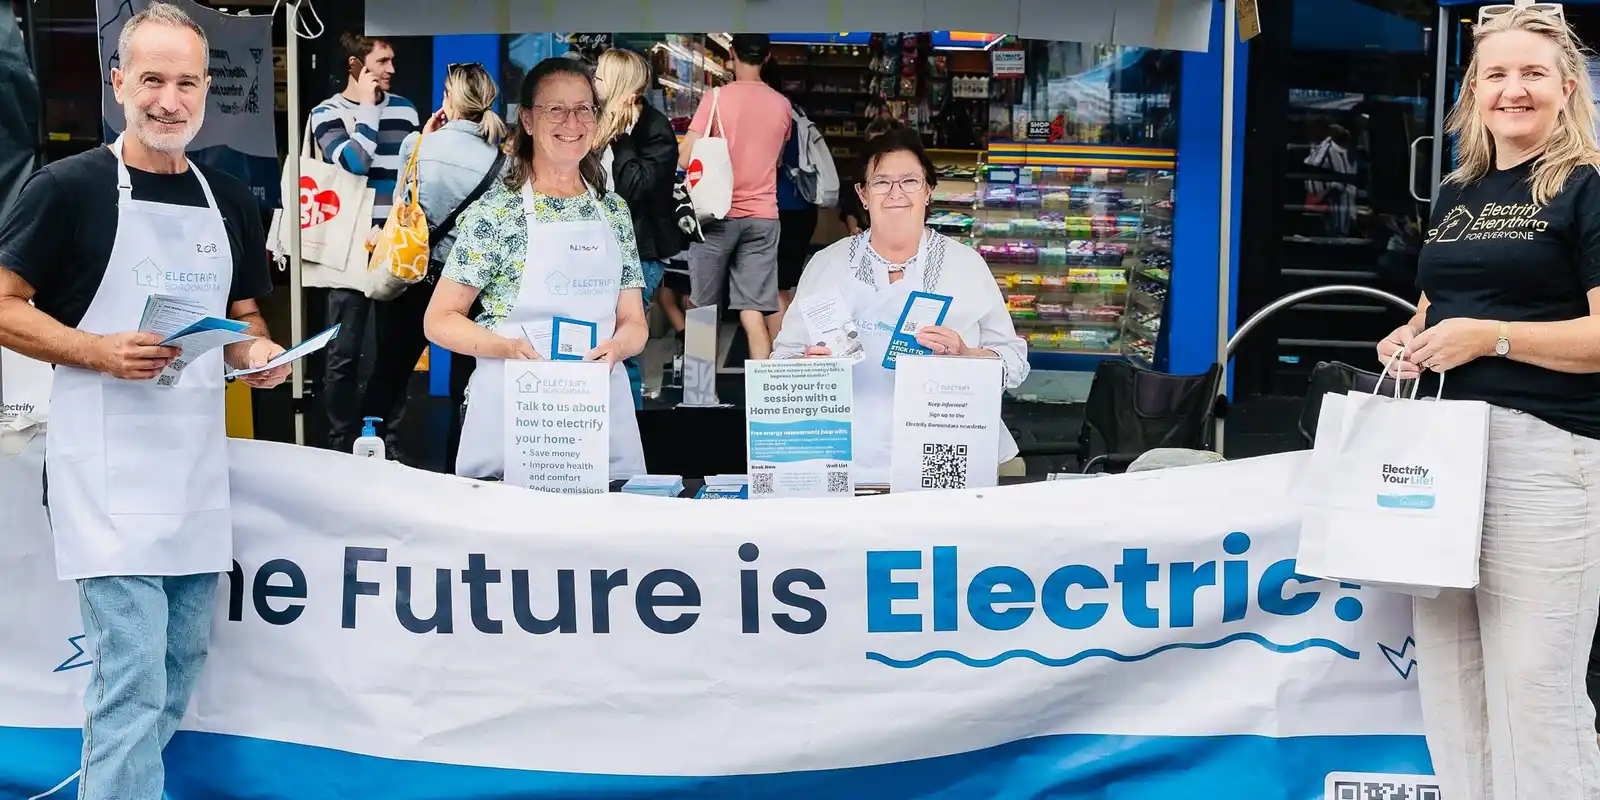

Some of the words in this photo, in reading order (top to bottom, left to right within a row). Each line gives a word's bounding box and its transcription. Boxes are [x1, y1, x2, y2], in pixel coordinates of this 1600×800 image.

[1480, 202, 1542, 218] Electrify
[1471, 216, 1549, 232] Everything
[1482, 231, 1534, 240] EVERYONE
[196, 243, 217, 253] ROB
[165, 272, 217, 282] ELECTRIFY
[791, 384, 815, 393] your
[817, 382, 837, 390] free
[764, 394, 803, 402] session
[805, 393, 828, 402] with
[5, 402, 34, 413] ectrify
[517, 401, 539, 411] Talk
[542, 402, 554, 411] to
[557, 404, 569, 412] us
[573, 403, 606, 412] about
[782, 406, 818, 416] Energy
[820, 405, 851, 413] Guide
[516, 418, 539, 427] how
[542, 418, 554, 427] to
[556, 418, 603, 431] electrify
[516, 435, 541, 445] your
[544, 434, 576, 444] home
[530, 449, 550, 457] Save
[552, 451, 580, 459] money
[530, 461, 565, 470] Improve
[1382, 464, 1429, 477] Electrify
[1382, 474, 1410, 484] Your
[1411, 476, 1434, 485] Life!
[563, 486, 604, 494] emissions
[341, 546, 701, 635] Future
[738, 543, 827, 635] is
